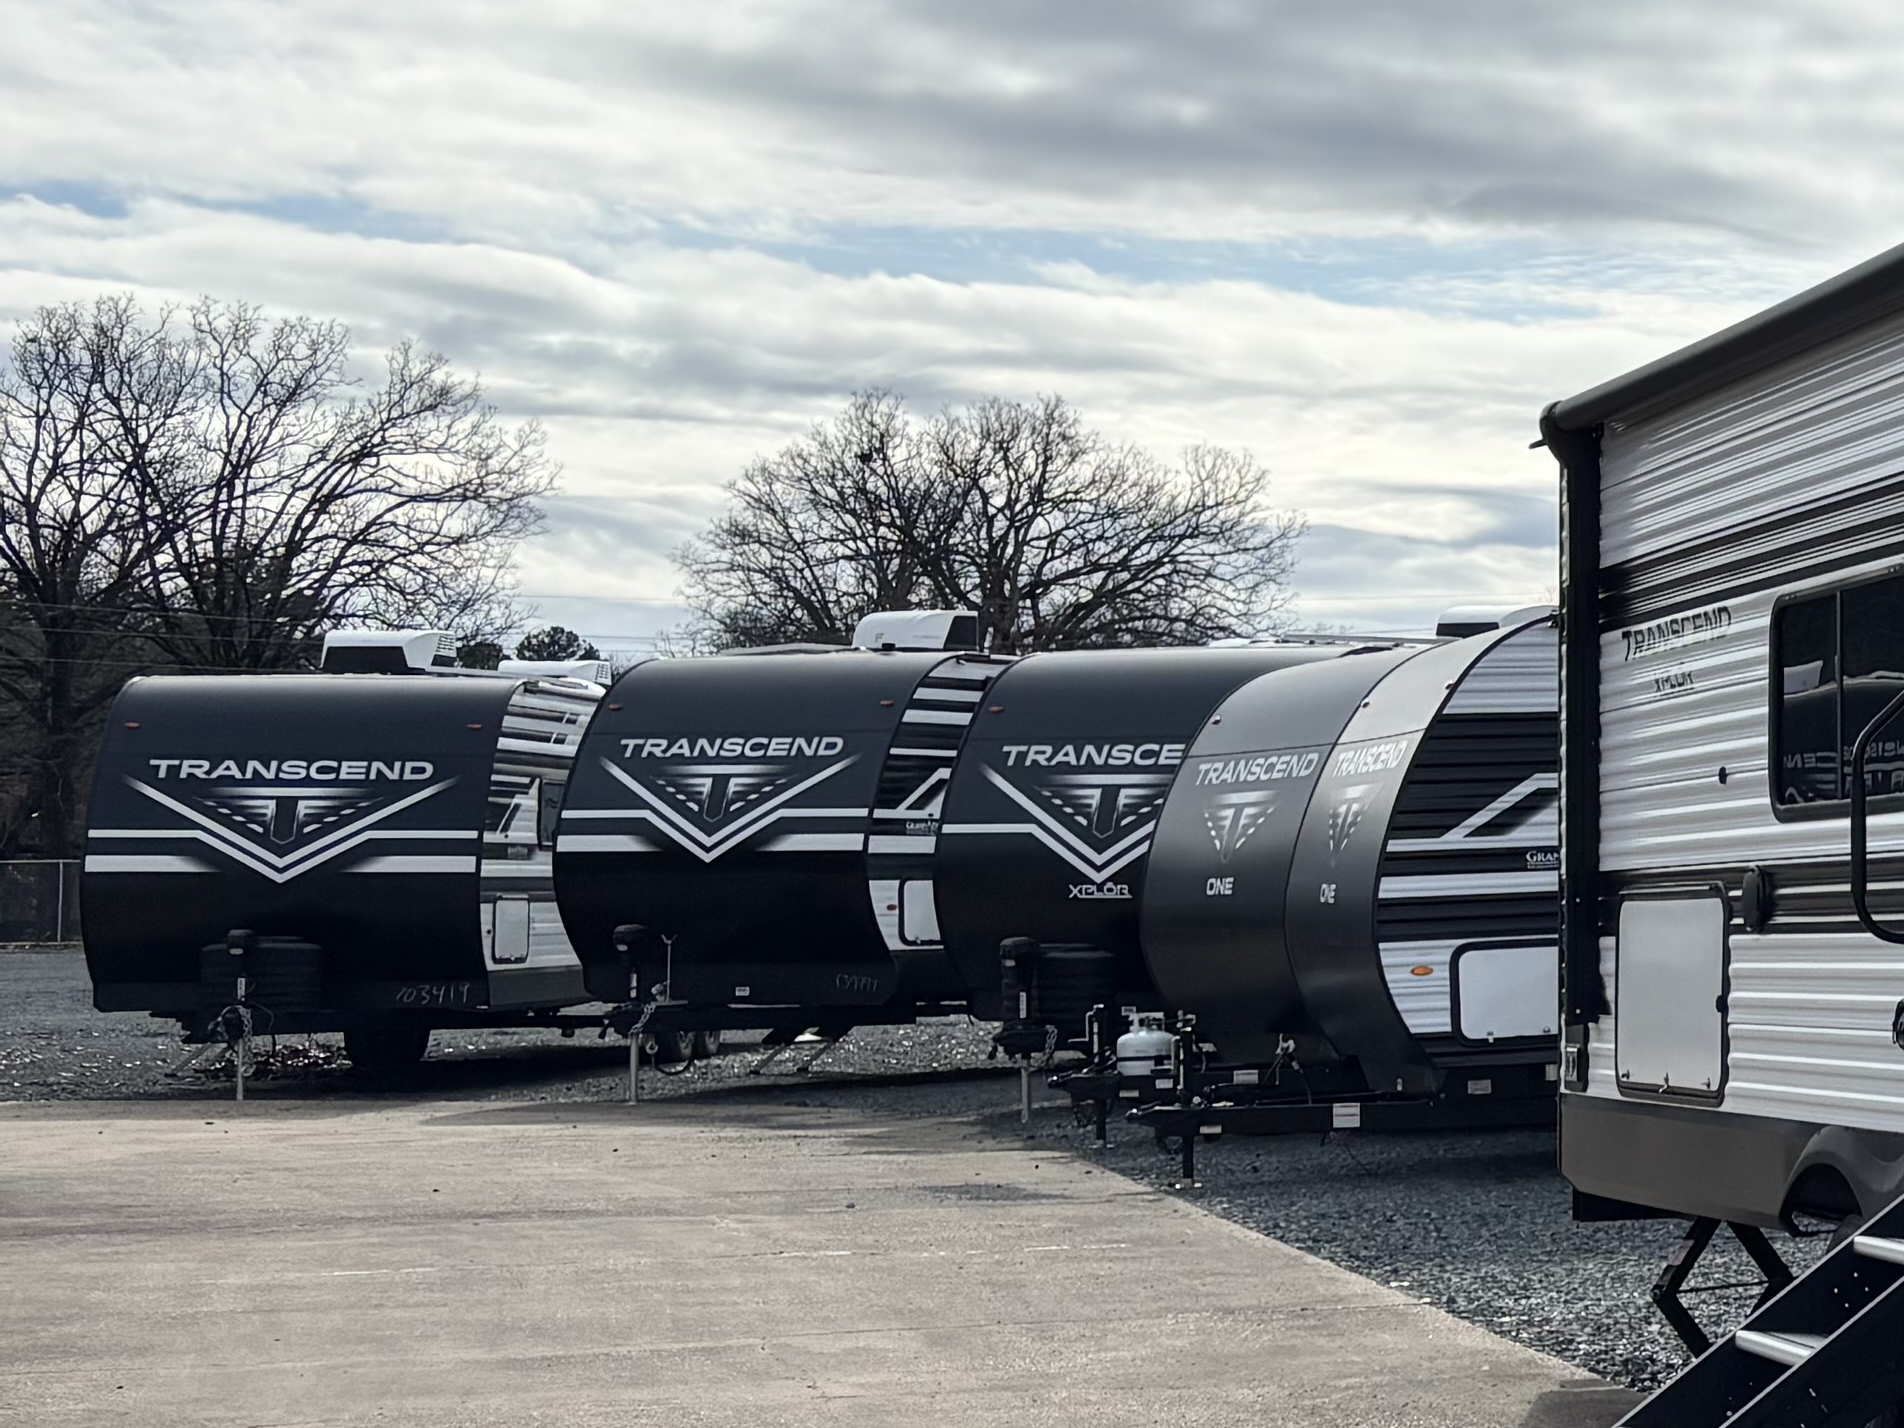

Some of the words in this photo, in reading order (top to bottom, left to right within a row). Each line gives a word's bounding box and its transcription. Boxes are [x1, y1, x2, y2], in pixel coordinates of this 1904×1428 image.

[620, 736, 844, 758] TRANSCEND
[1002, 743, 1186, 766] TRANSCE
[1195, 752, 1320, 786] TRANSCEND
[1332, 739, 1408, 778] TRANSCEND
[149, 759, 434, 781] TRANSCEND
[1206, 877, 1234, 896] ONE
